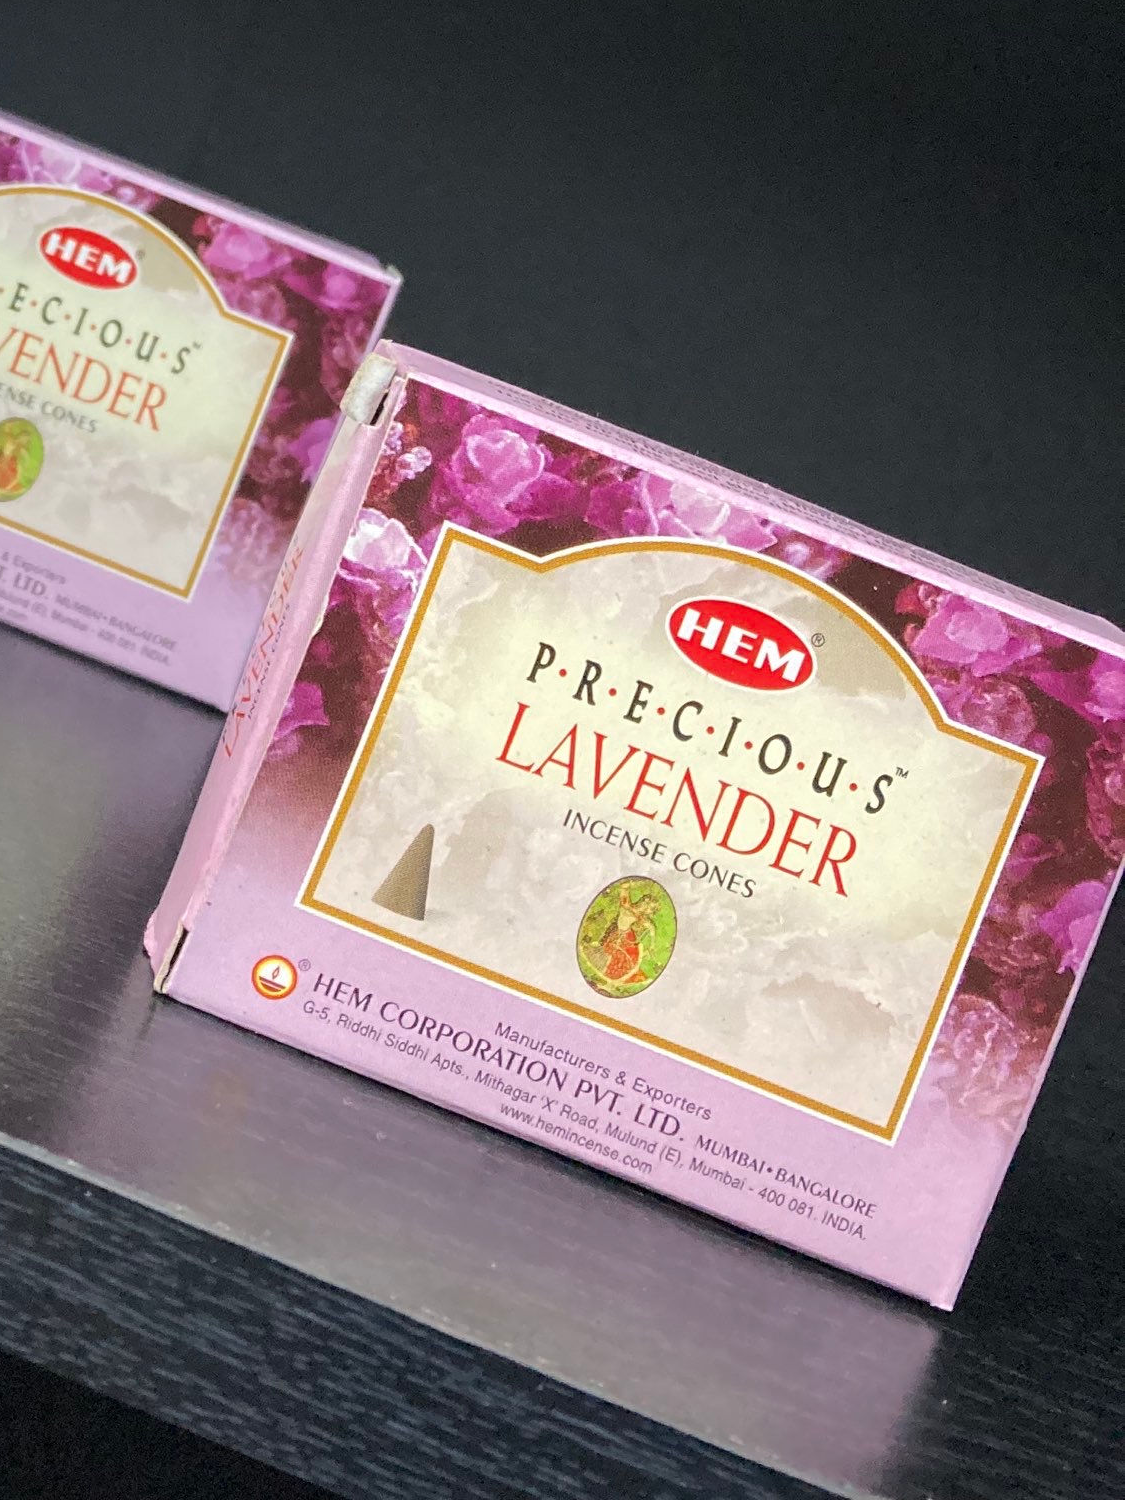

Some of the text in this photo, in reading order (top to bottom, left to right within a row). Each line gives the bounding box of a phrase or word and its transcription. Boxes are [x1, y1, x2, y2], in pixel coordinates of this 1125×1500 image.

[44, 232, 132, 284] HEM
[41, 399, 98, 434] CONES
[677, 608, 805, 683] HEM
[496, 701, 857, 898] LAVENDER
[563, 808, 756, 899] INCENSE CONES
[314, 973, 373, 1012] HEM
[380, 1000, 568, 1092] CORPORATION
[575, 1079, 621, 1116] PVT.
[634, 1103, 684, 1142] LTD.
[494, 1022, 712, 1121] Manufacturers & Exporters
[337, 1013, 382, 1041] Riddhi
[384, 1033, 428, 1061] Siddhi
[474, 1070, 537, 1105] Mithagar
[560, 1103, 599, 1132] Road,
[605, 1122, 657, 1154] Mulund
[688, 1156, 746, 1191] Mumbai
[757, 1186, 786, 1207] 400
[500, 1103, 653, 1175] www.hemincense.com
